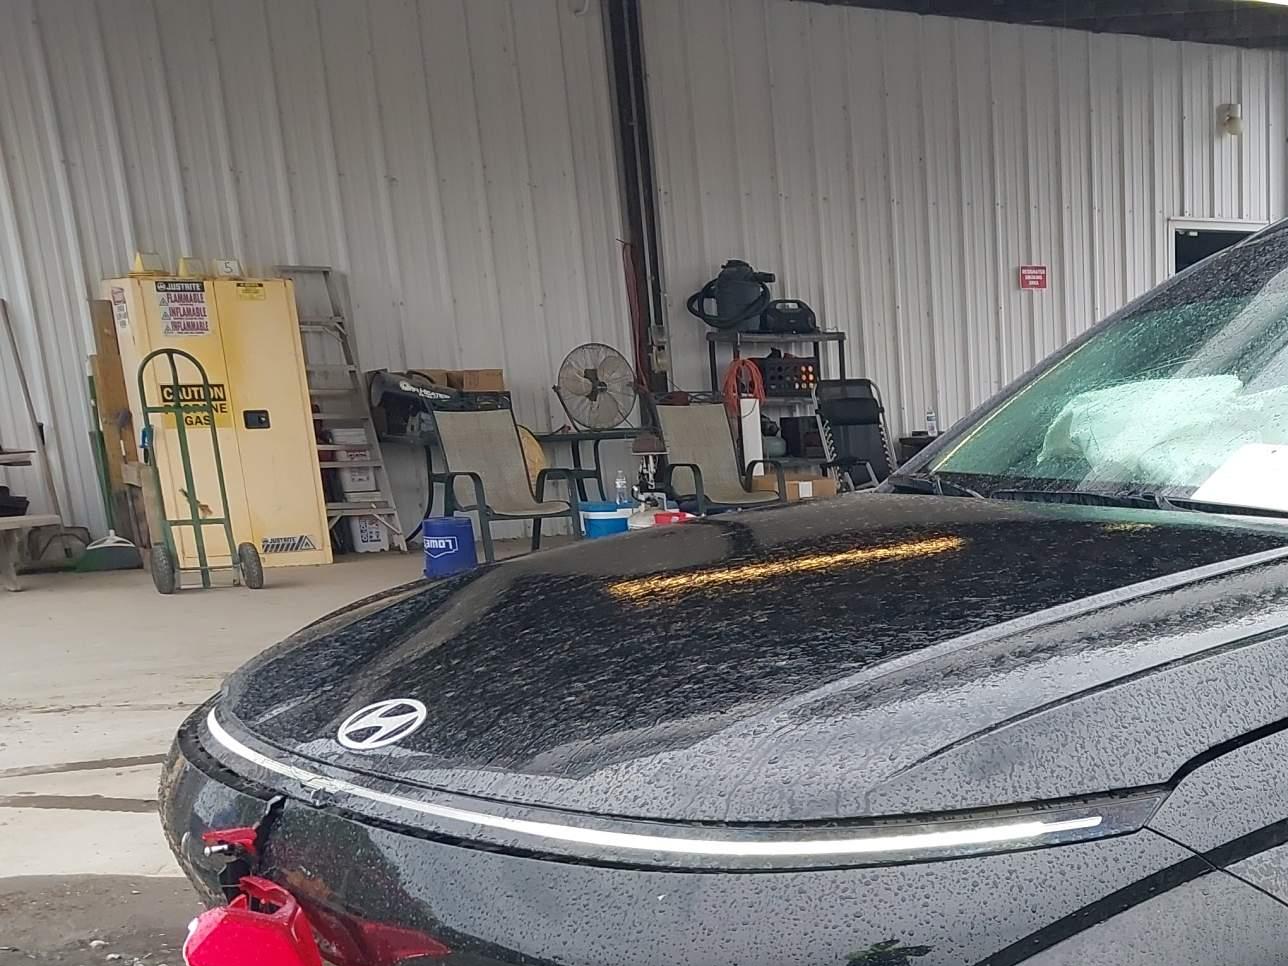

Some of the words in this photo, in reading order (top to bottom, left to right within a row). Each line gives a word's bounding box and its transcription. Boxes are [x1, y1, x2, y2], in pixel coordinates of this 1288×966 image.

[223, 261, 233, 274] 5
[166, 282, 202, 291] JUSTRITE
[166, 293, 205, 304] FLAMMABLE
[168, 306, 208, 318] INFLAMABLE
